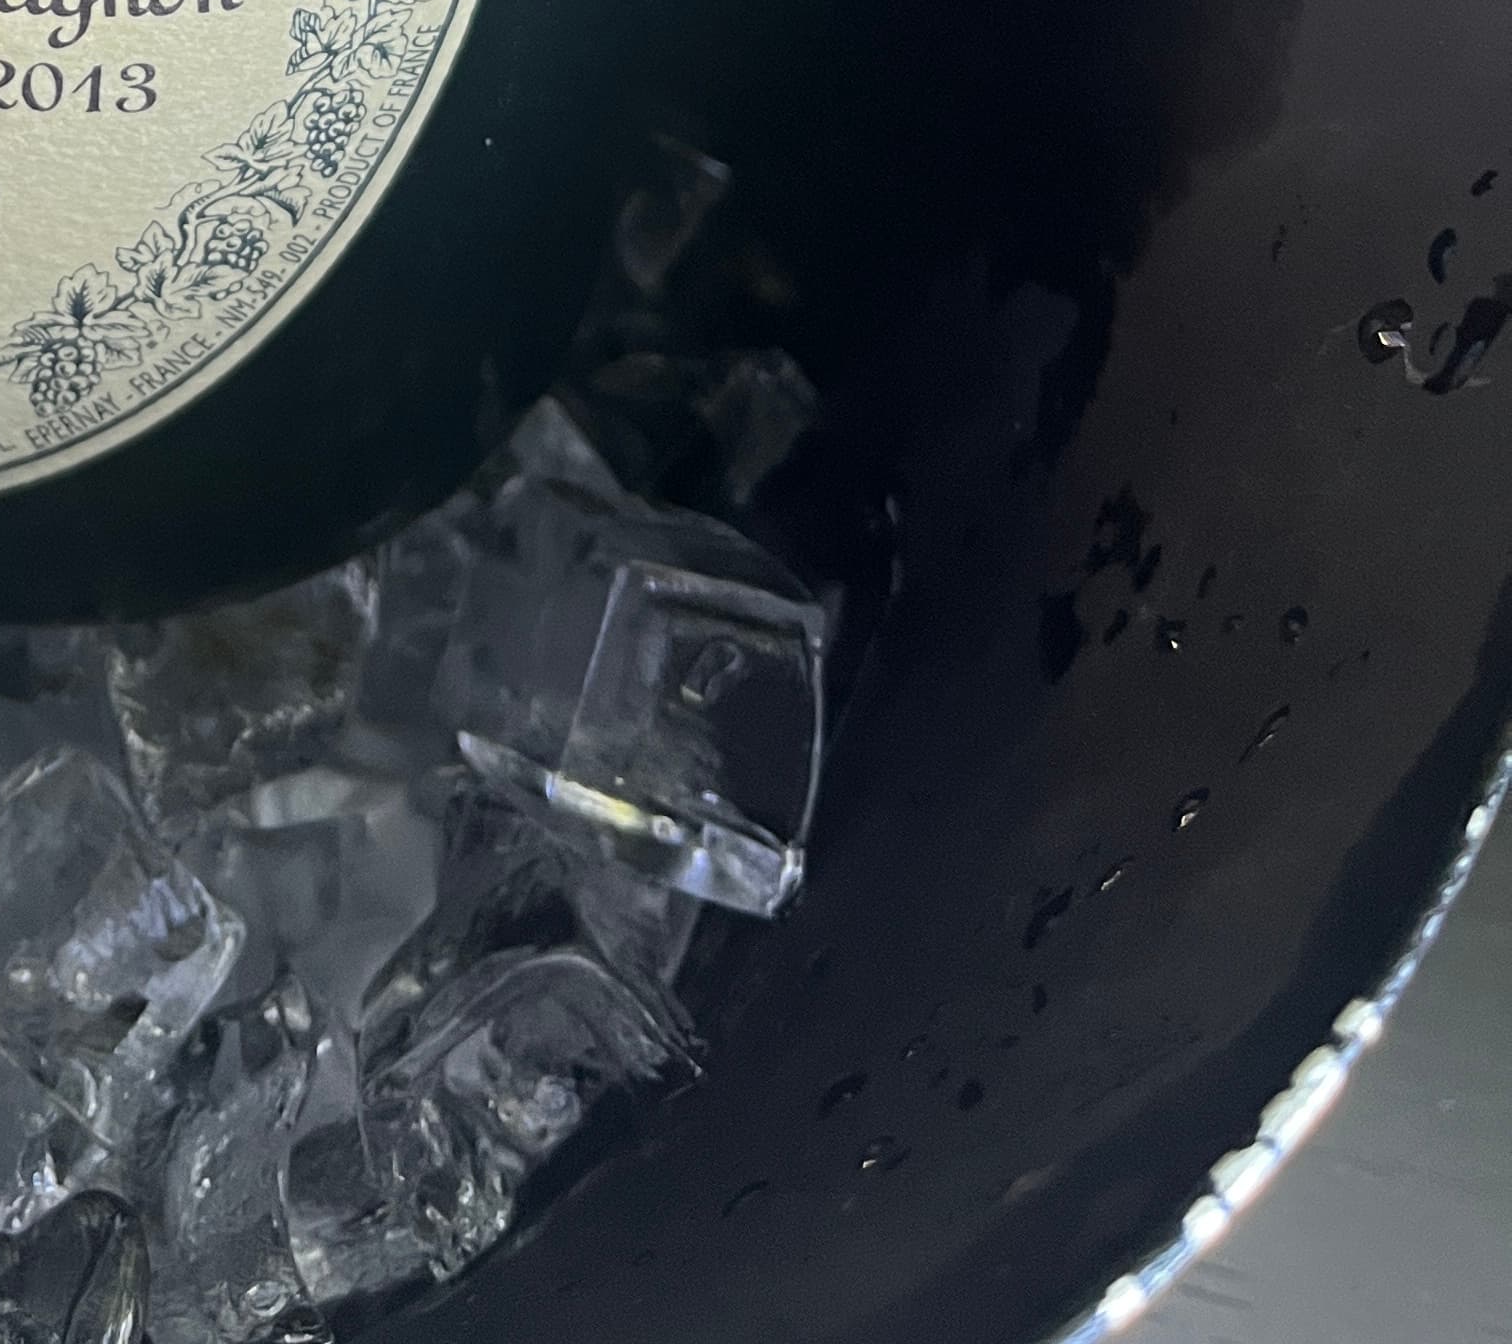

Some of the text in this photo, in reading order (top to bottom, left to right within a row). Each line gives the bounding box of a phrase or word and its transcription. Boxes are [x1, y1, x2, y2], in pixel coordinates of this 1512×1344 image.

[315, 24, 441, 220] PRODUCT OF FRANCE
[24, 392, 122, 451] EPERNAY
[129, 332, 214, 397] FRANCE
